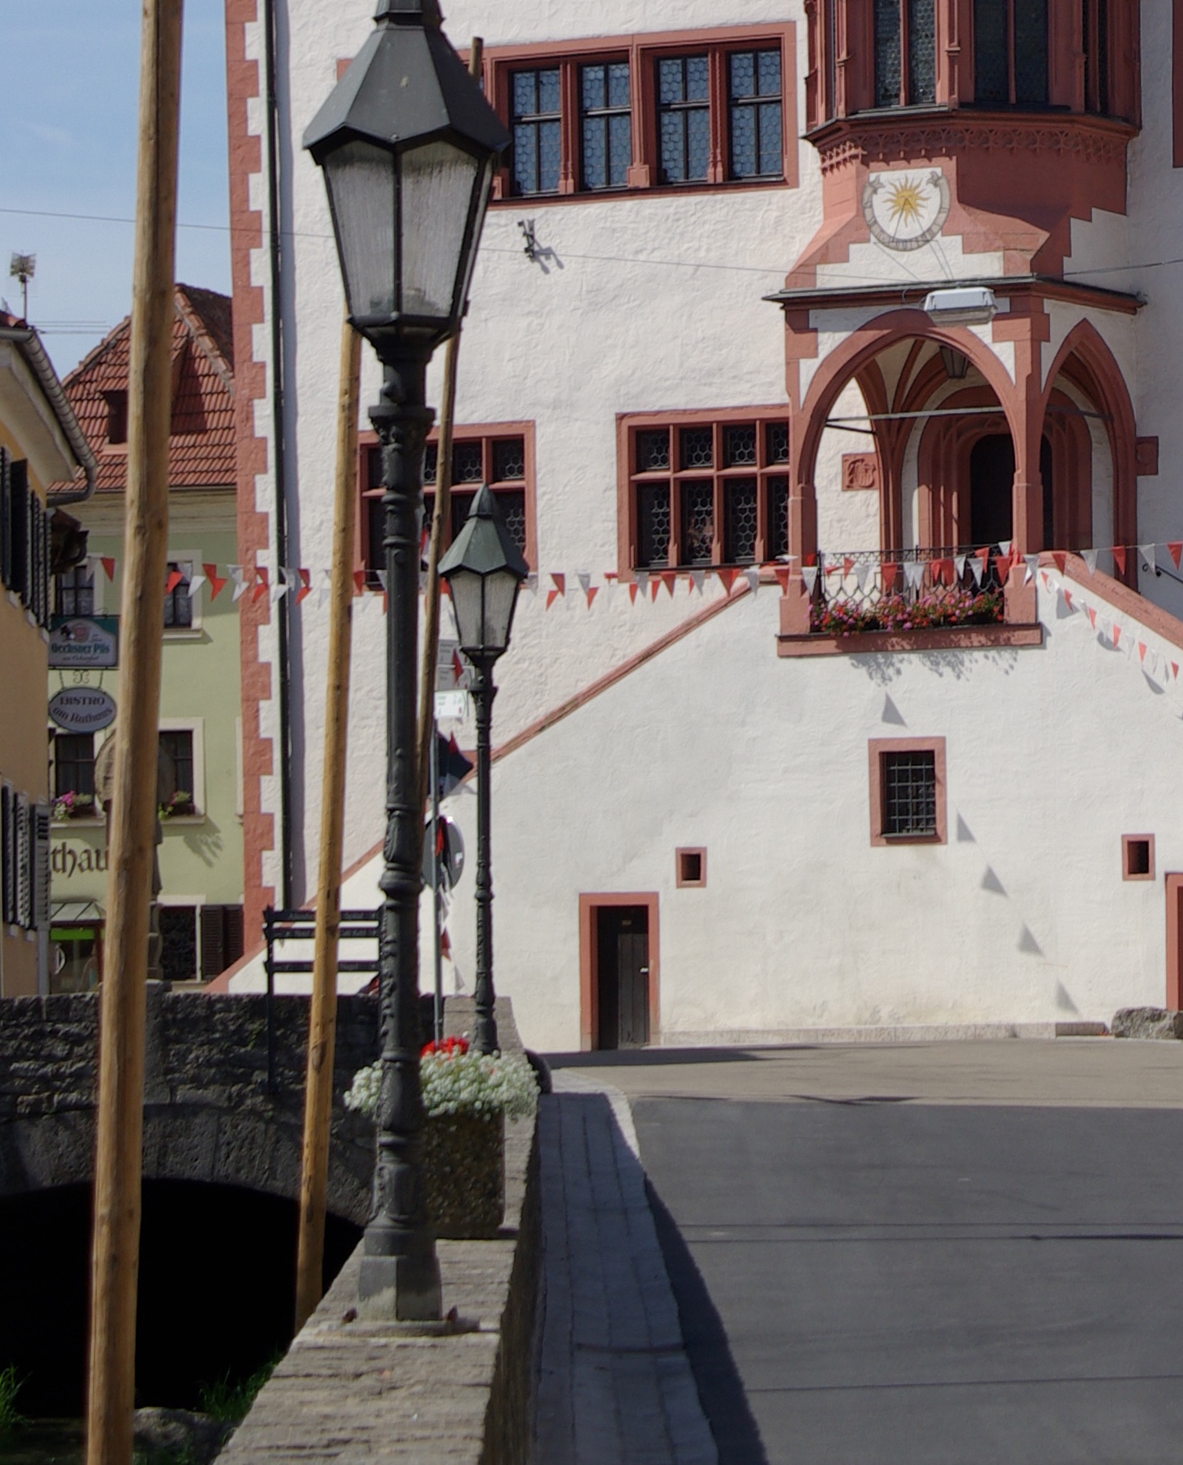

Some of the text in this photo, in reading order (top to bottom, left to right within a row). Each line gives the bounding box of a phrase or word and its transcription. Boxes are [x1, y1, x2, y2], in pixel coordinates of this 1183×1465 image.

[60, 696, 106, 706] BISTRO
[52, 707, 113, 724] am Rathaus
